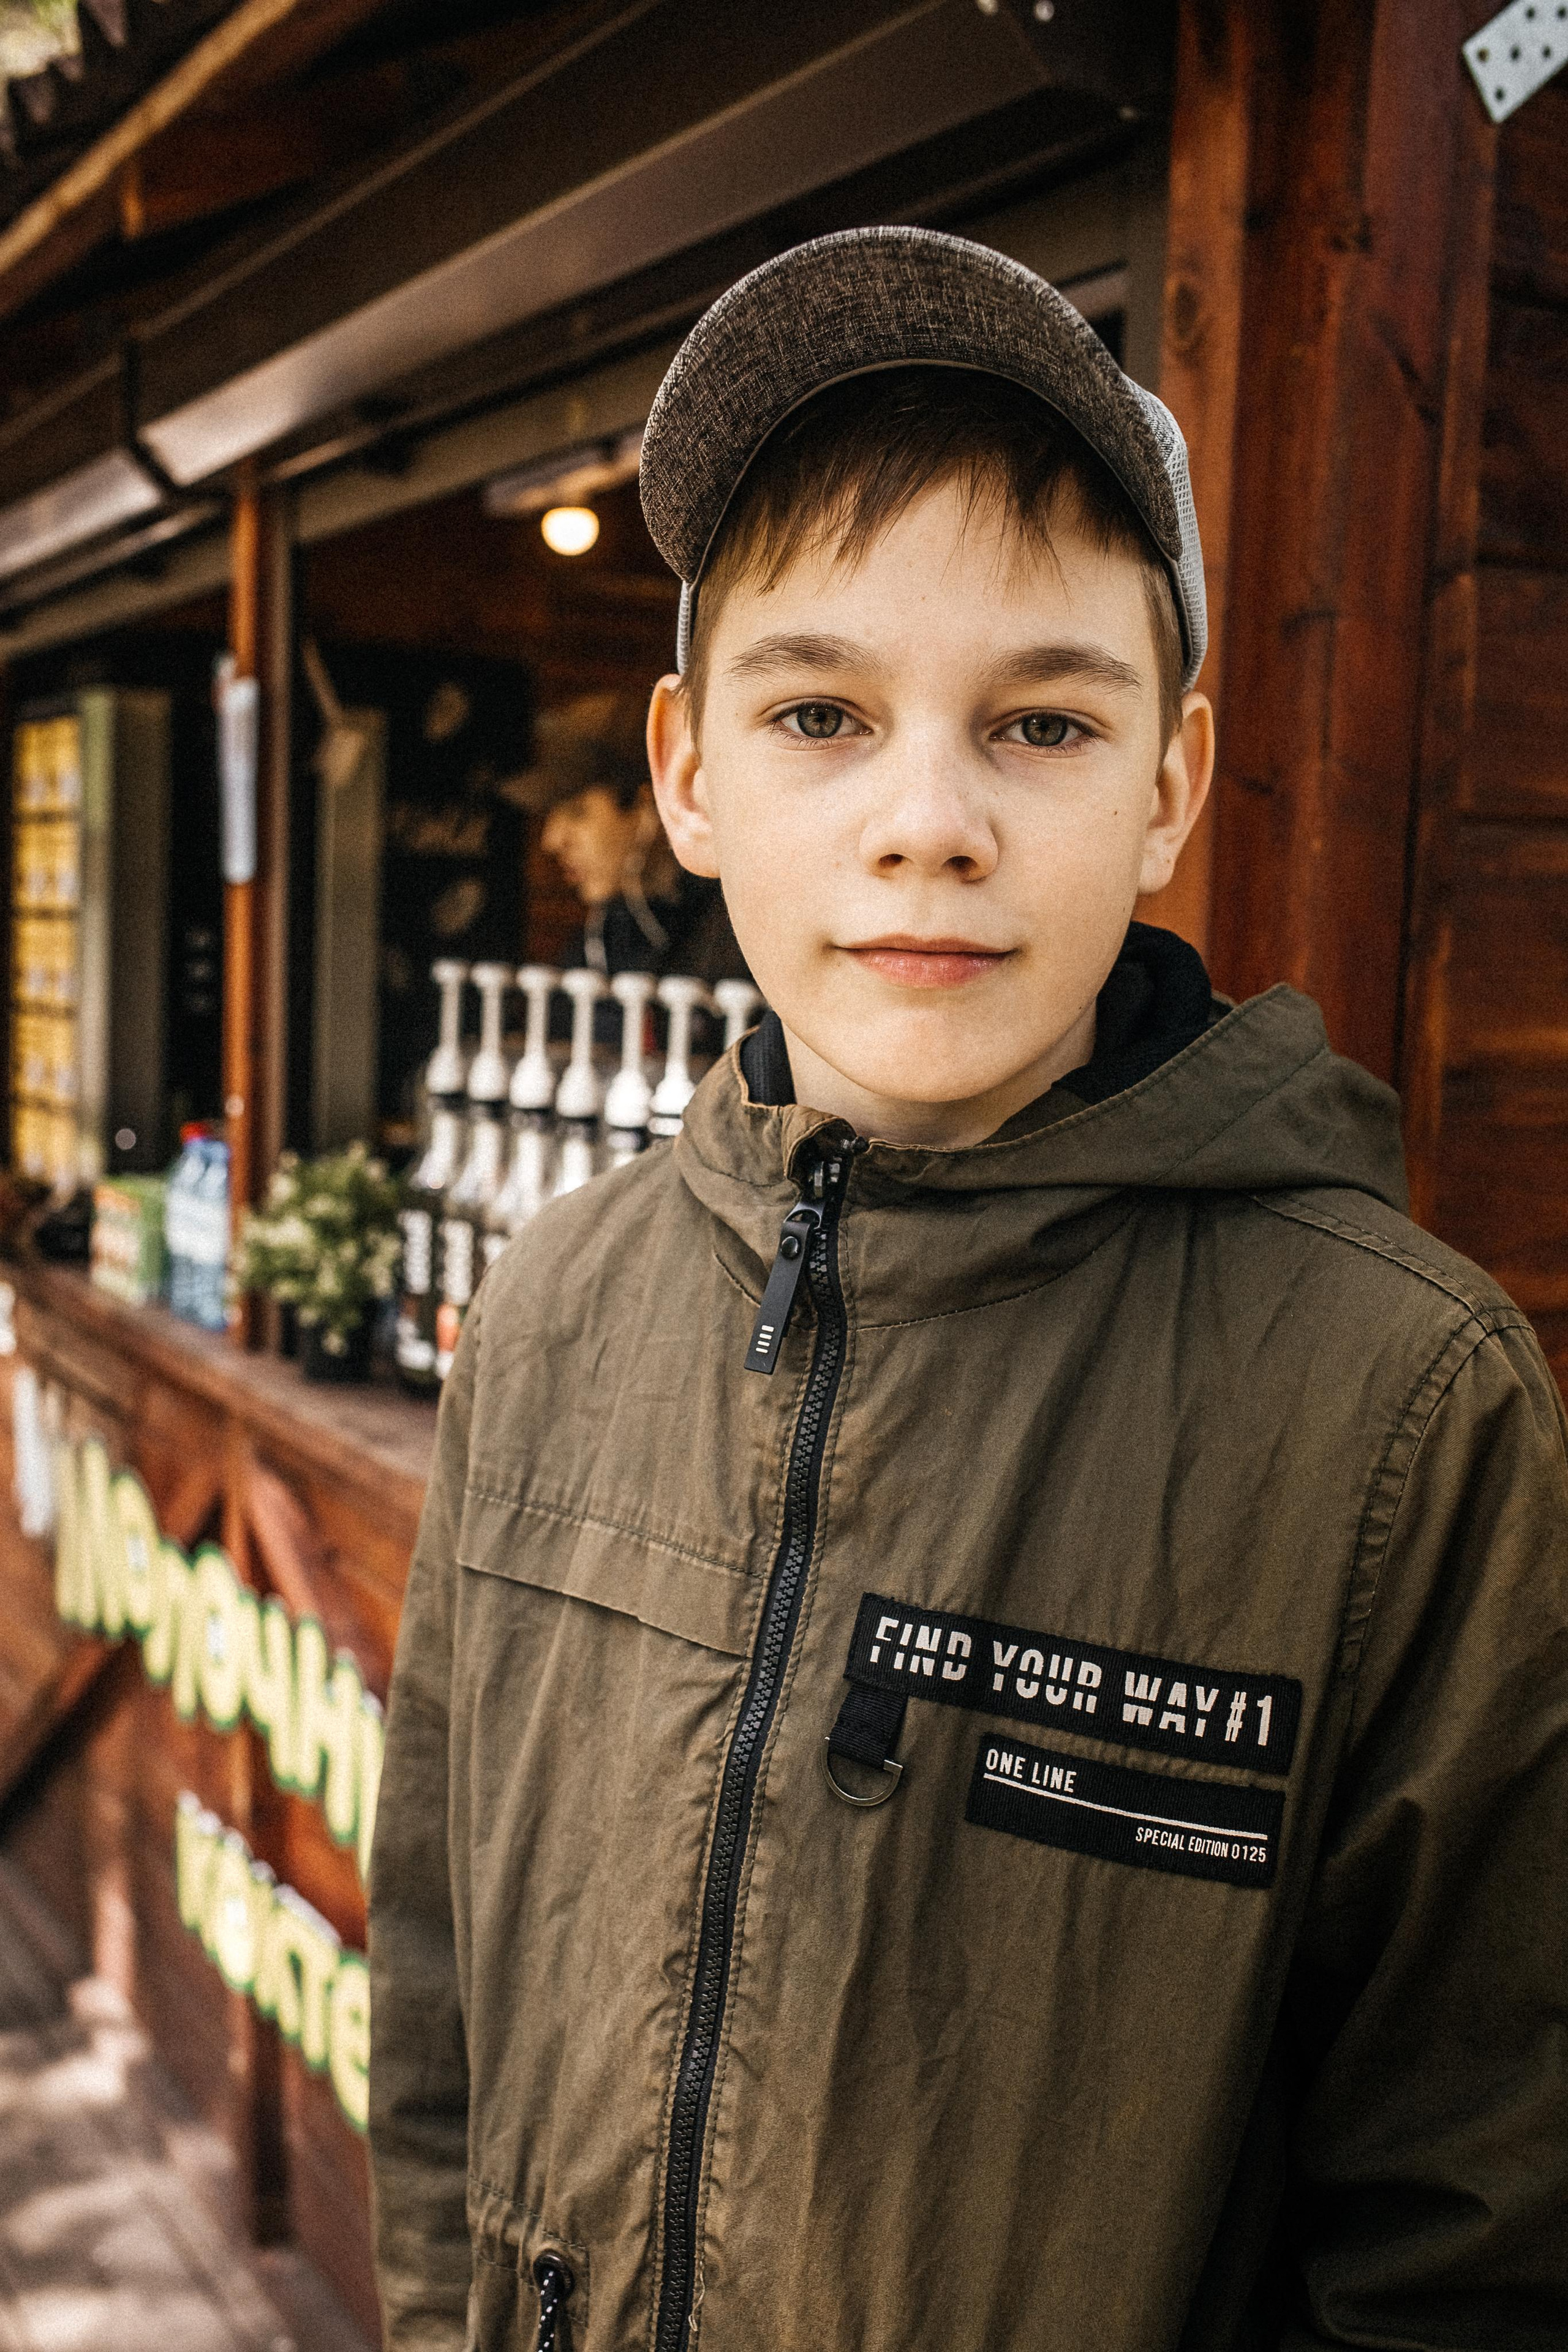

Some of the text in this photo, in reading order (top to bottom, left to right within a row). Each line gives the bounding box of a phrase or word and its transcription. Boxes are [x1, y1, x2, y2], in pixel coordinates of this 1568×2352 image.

[869, 1616, 973, 1681] FIND
[992, 1640, 1102, 1714] YOUR
[986, 1748, 1077, 1793] ONE LINE
[1135, 1826, 1185, 1850] SPECIAL
[1188, 1836, 1229, 1858] EDITION
